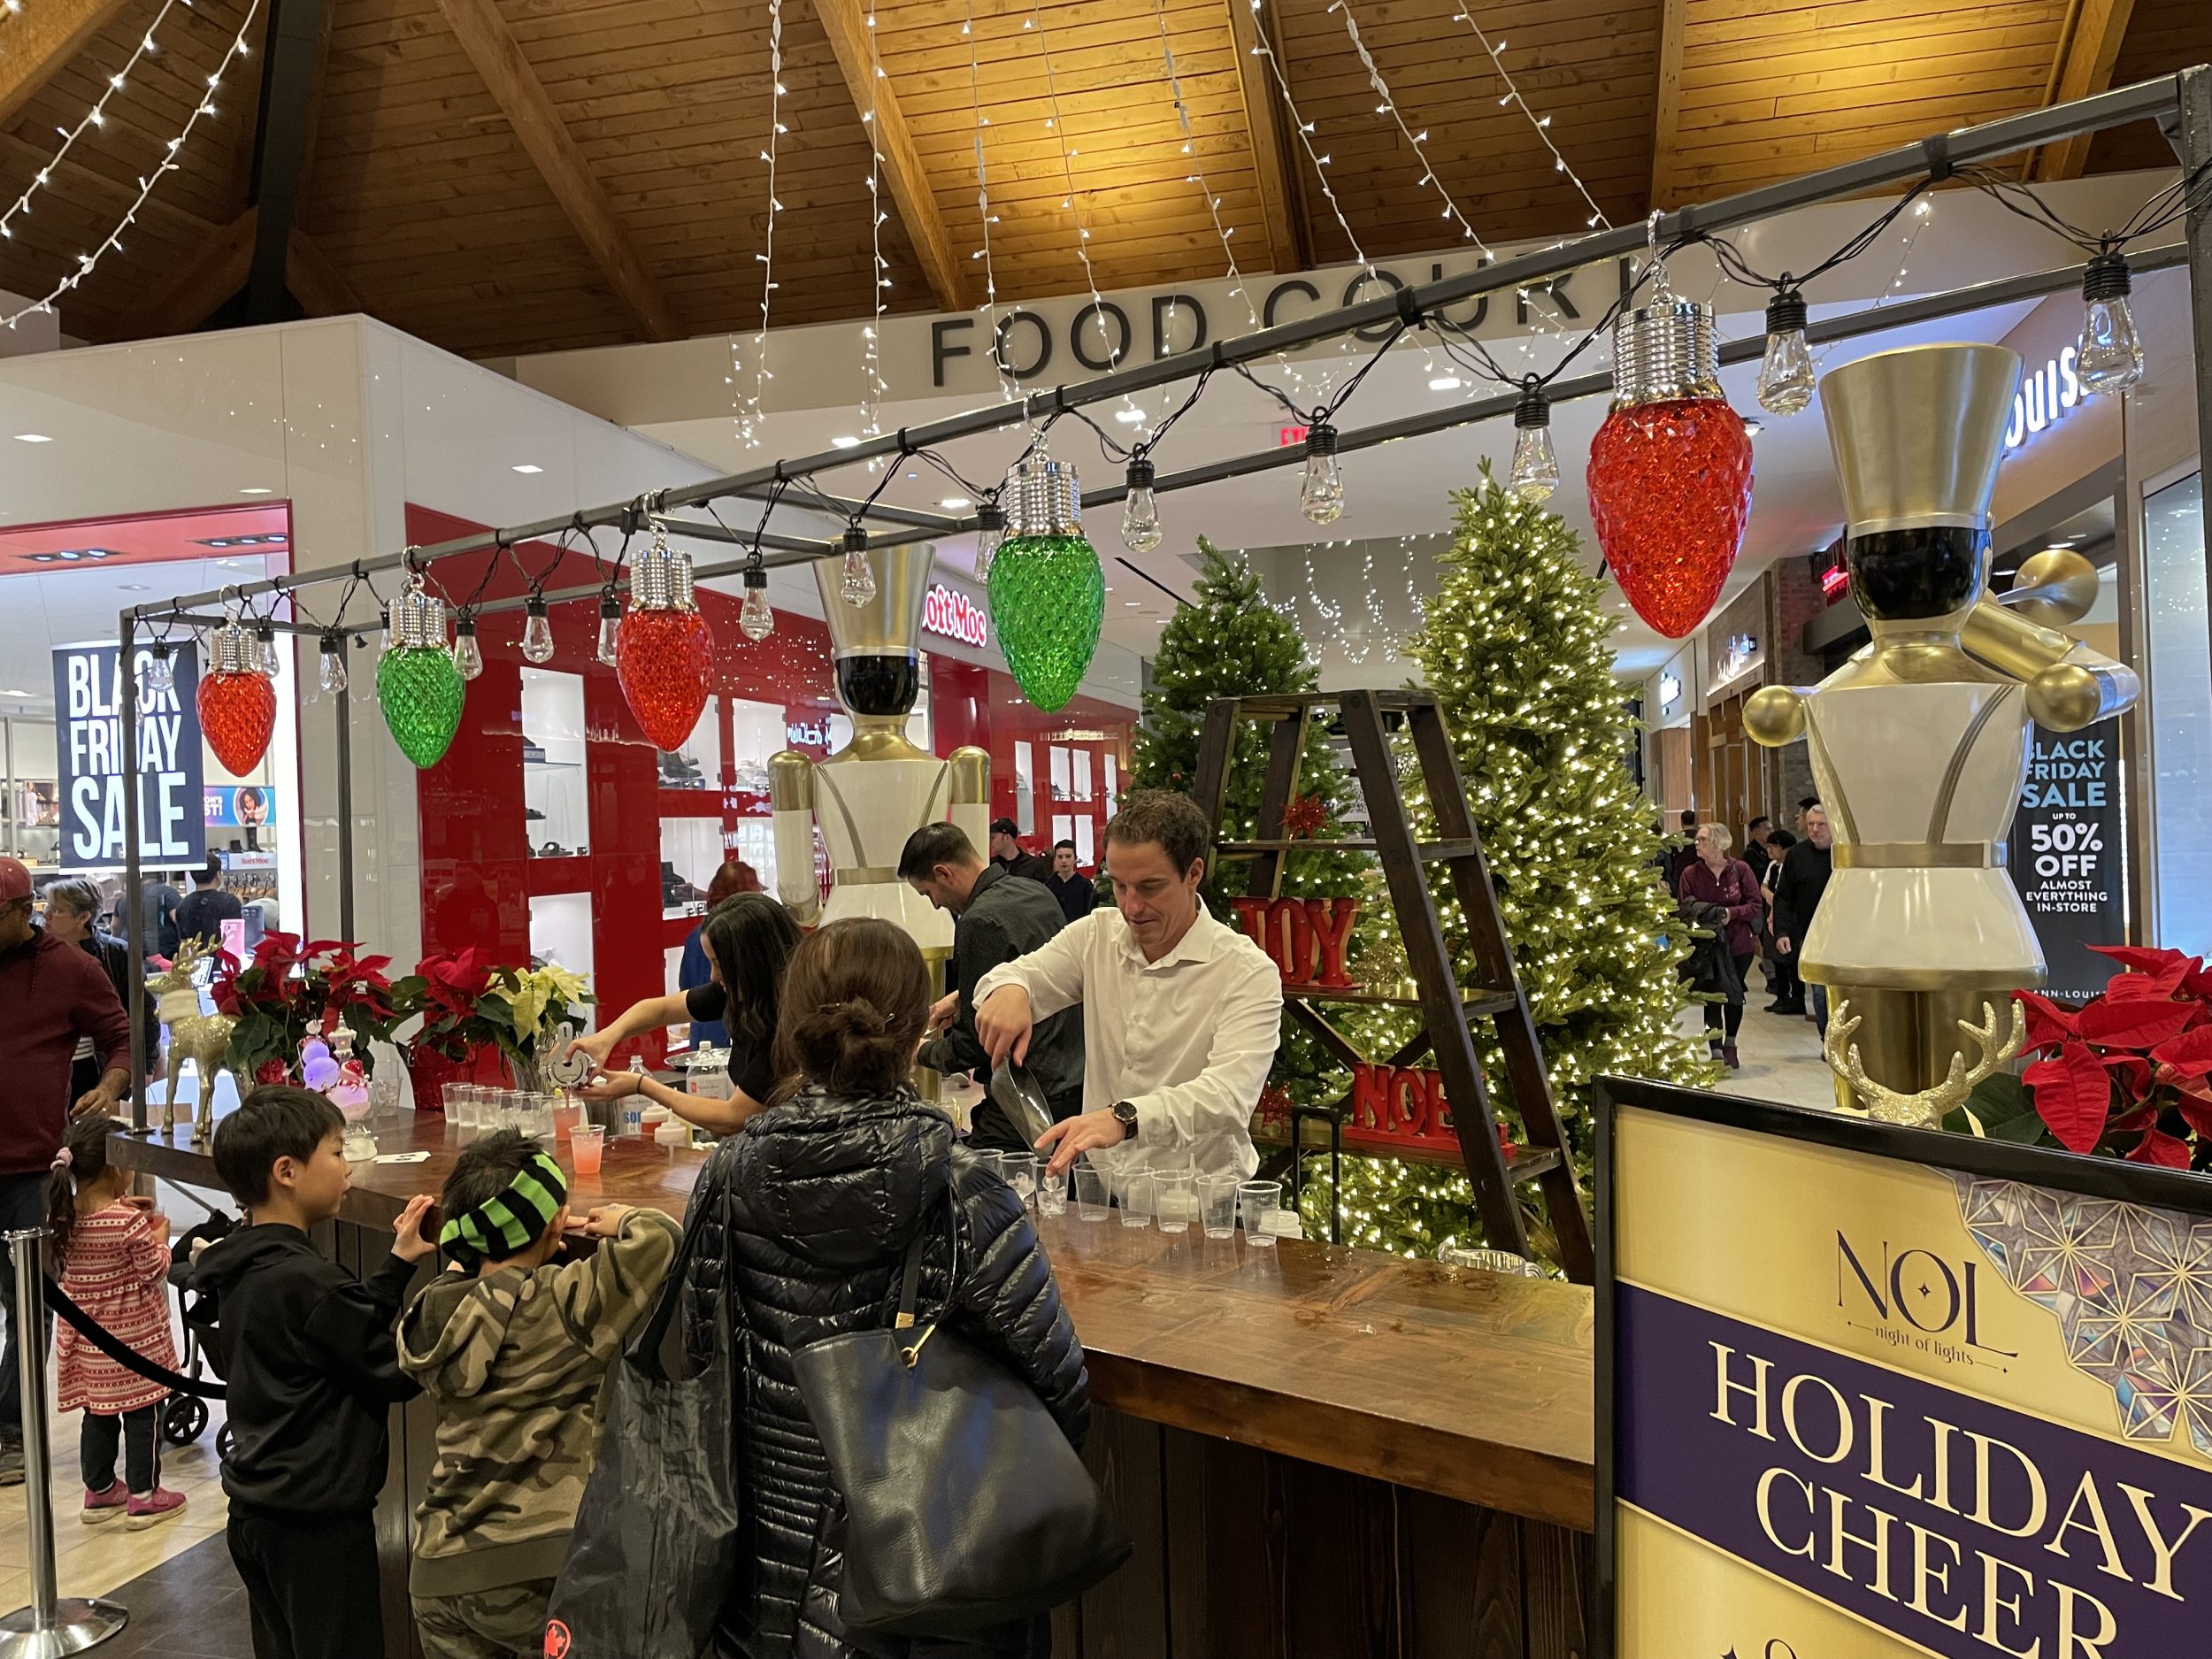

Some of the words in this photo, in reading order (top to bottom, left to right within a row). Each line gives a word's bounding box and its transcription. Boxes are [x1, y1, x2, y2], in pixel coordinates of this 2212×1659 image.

[932, 295, 1207, 388] FOOD
[1280, 426, 1310, 447] EXI
[922, 584, 987, 647] oftMoc
[2022, 782, 2106, 808] SALE
[72, 772, 188, 860] SALE
[2032, 823, 2103, 852] 50%
[2035, 855, 2097, 877] OFF
[2040, 880, 2092, 890] ALMOST
[2026, 891, 2108, 902] EVERYTHING
[2037, 902, 2098, 912] IN-STORE
[1353, 1062, 1508, 1147] NOE
[1836, 1229, 2019, 1358] NOL
[1875, 1327, 1909, 1346] night
[1916, 1339, 1931, 1351] of
[1934, 1340, 1974, 1365] lights
[1709, 1340, 2212, 1602] HOLIDAY
[1755, 1467, 2117, 1659] CHEER
